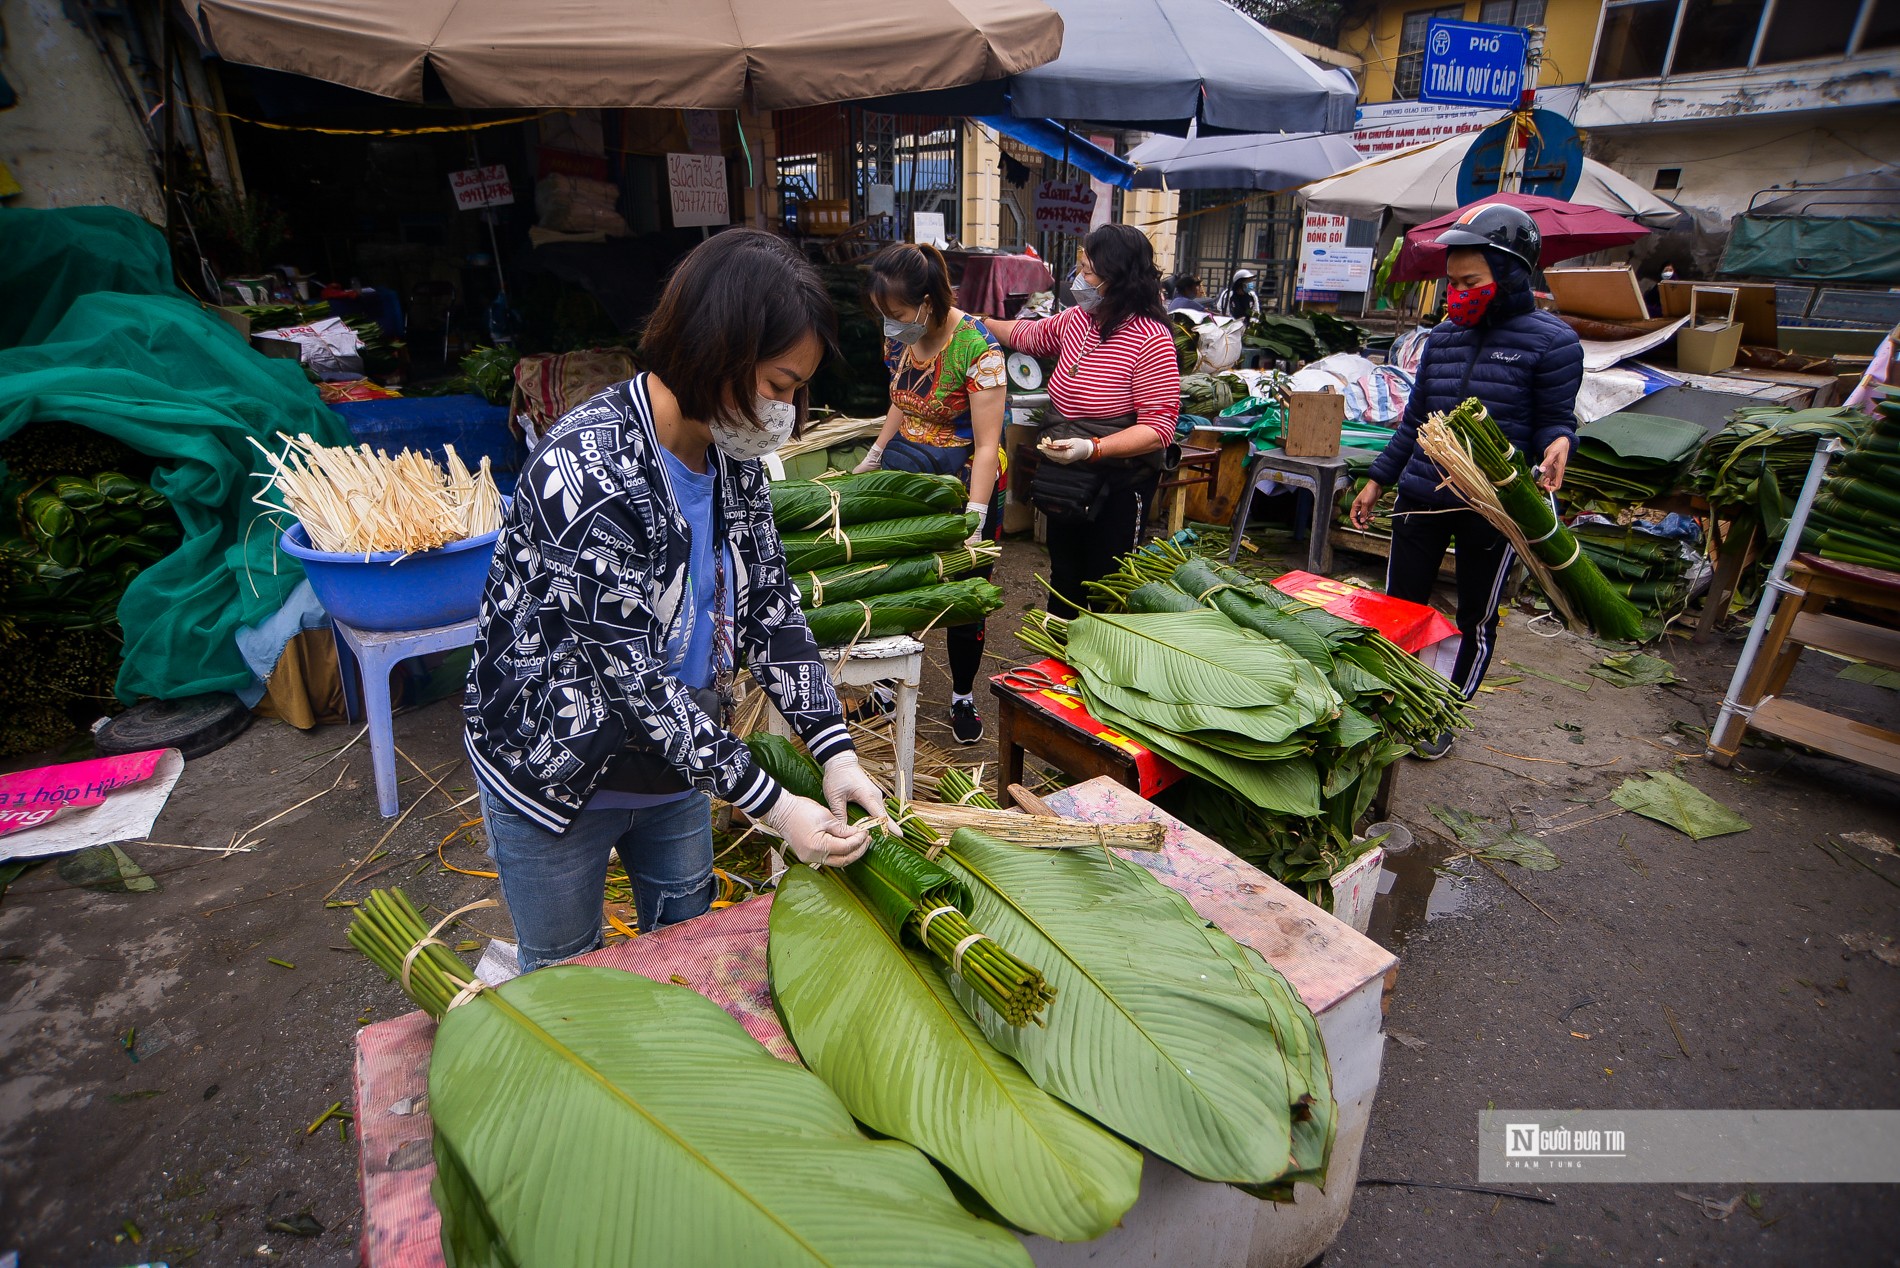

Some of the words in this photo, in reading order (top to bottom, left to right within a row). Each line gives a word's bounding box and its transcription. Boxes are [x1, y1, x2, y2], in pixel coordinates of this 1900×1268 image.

[1470, 33, 1502, 52] PHỐ
[1466, 63, 1491, 96] QUÝ
[1492, 65, 1516, 96] CÁP
[1353, 131, 1367, 142] VẬN
[1442, 126, 1453, 135] GA
[1306, 230, 1327, 243] ĐÓNG
[1329, 230, 1343, 243] GÓI
[551, 405, 612, 435] adidas
[579, 431, 615, 494] adidas
[626, 477, 646, 488] adidas
[590, 527, 637, 554] adidas
[762, 522, 776, 556] adidas
[796, 664, 811, 710] adidas
[675, 733, 691, 763] adidas
[32, 784, 81, 806] hộp
